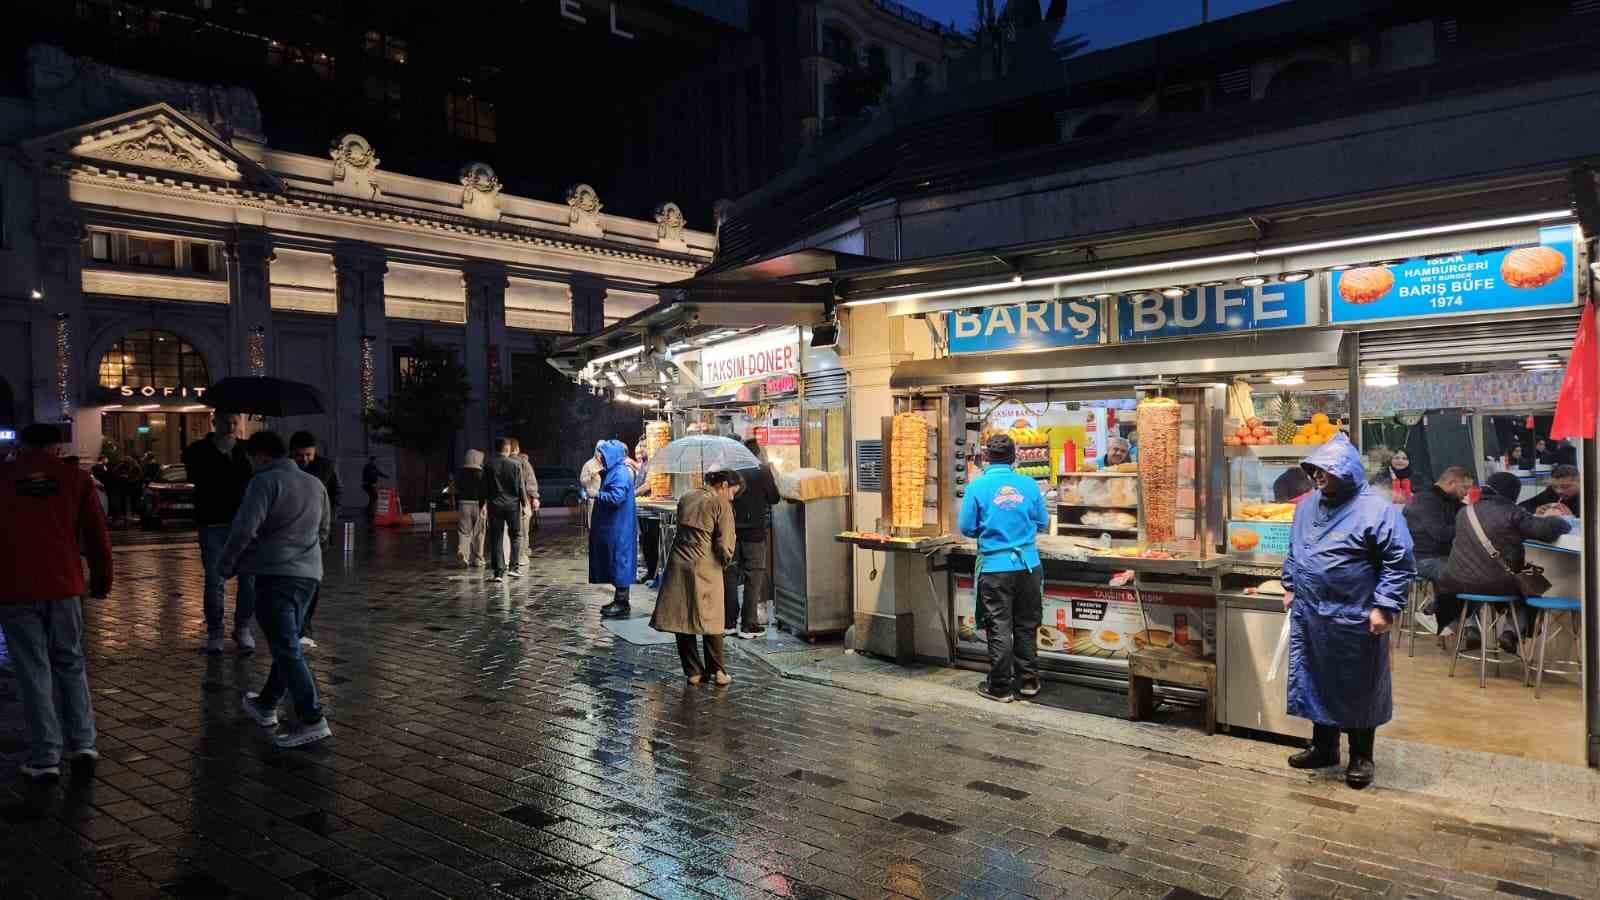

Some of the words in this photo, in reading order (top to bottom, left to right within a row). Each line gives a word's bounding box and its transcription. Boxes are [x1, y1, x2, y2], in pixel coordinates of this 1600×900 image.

[1399, 283, 1447, 297] BARIŞ
[1451, 278, 1496, 293] BÜFE
[1429, 295, 1464, 308] 1974
[955, 300, 1097, 338] BARIŞ
